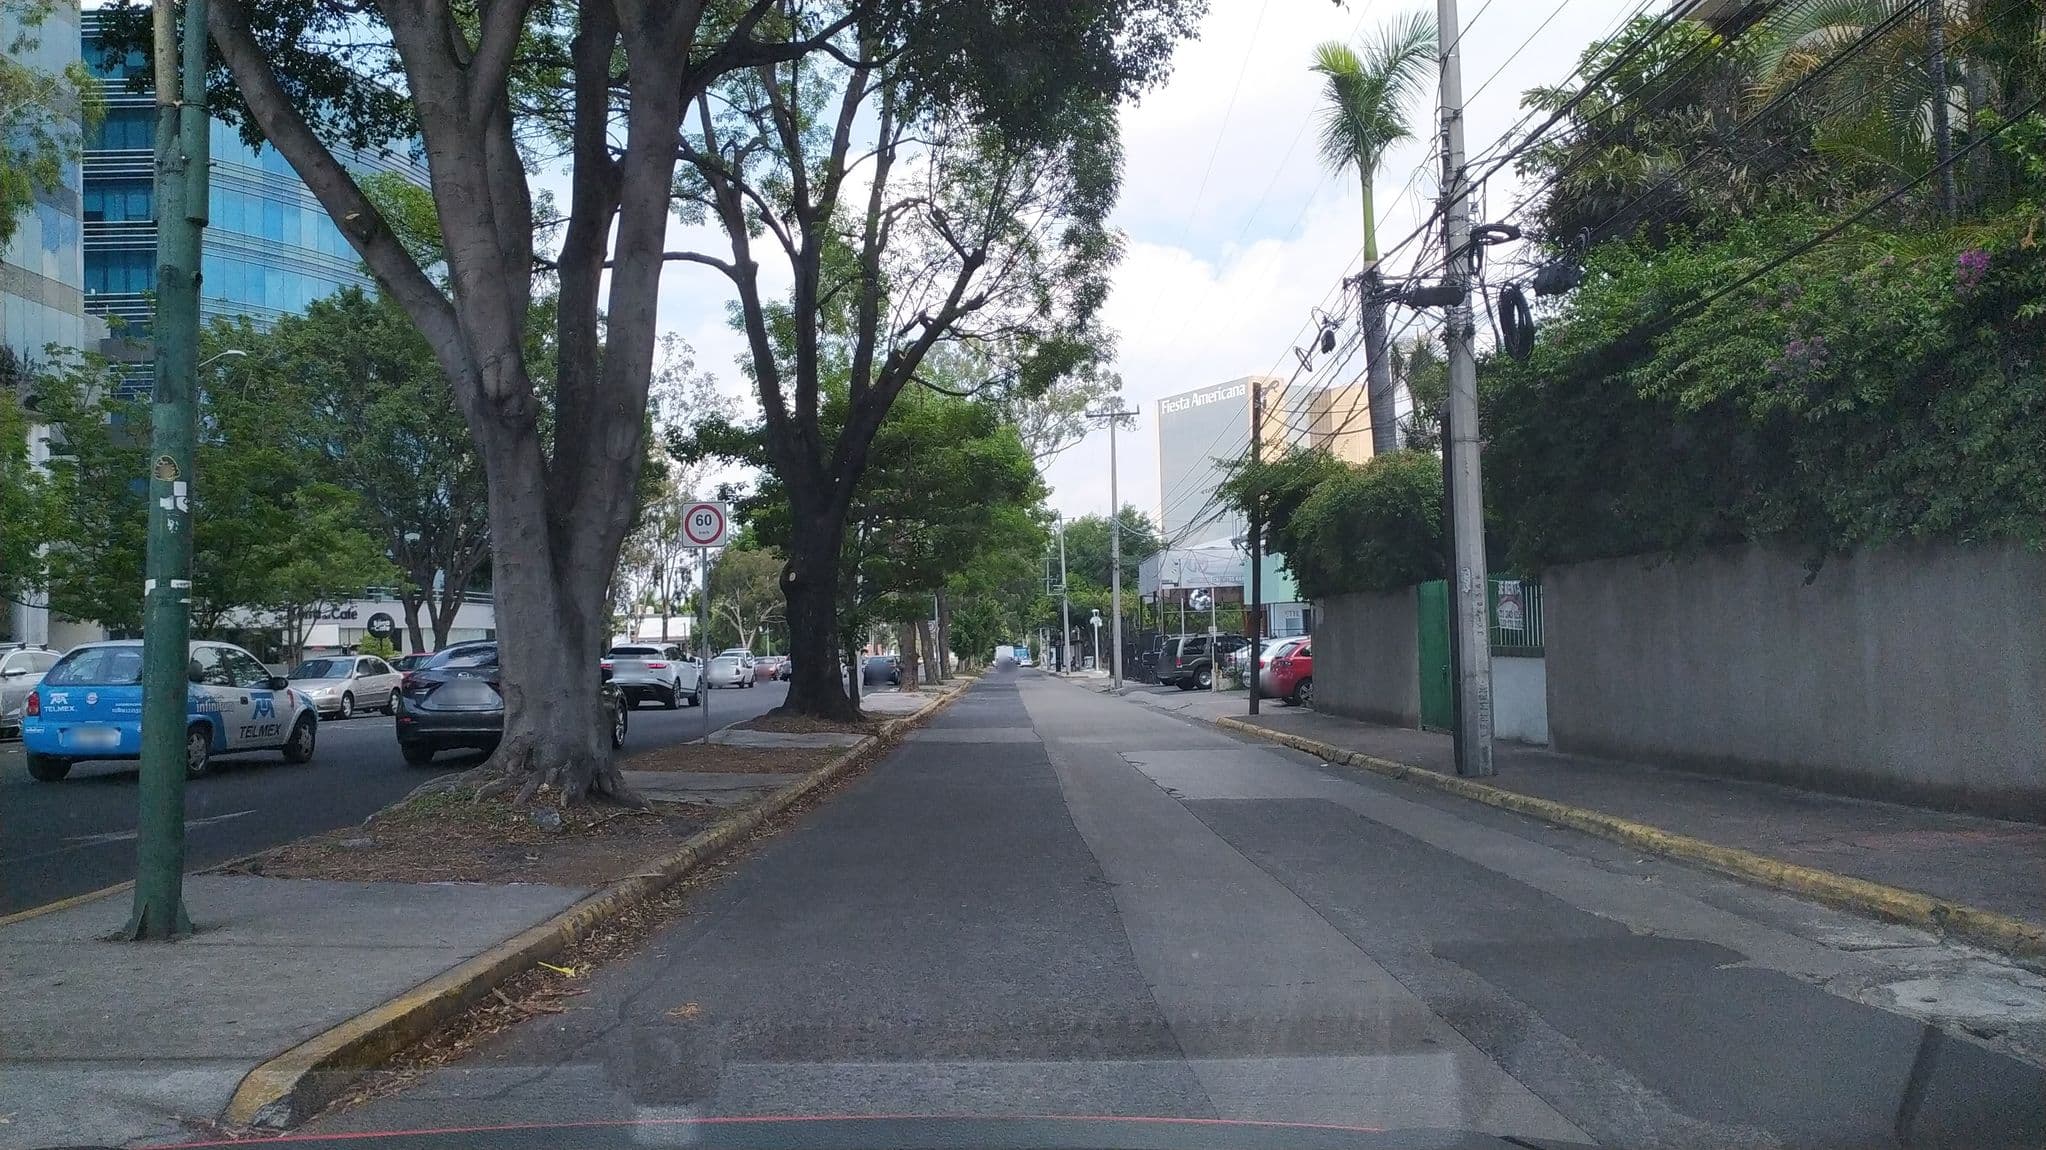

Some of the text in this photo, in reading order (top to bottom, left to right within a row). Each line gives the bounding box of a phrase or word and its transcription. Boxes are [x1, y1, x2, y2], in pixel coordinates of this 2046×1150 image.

[1161, 384, 1247, 414] Fiesta Americana
[695, 514, 712, 527] 60
[240, 723, 281, 739] TELMEX
